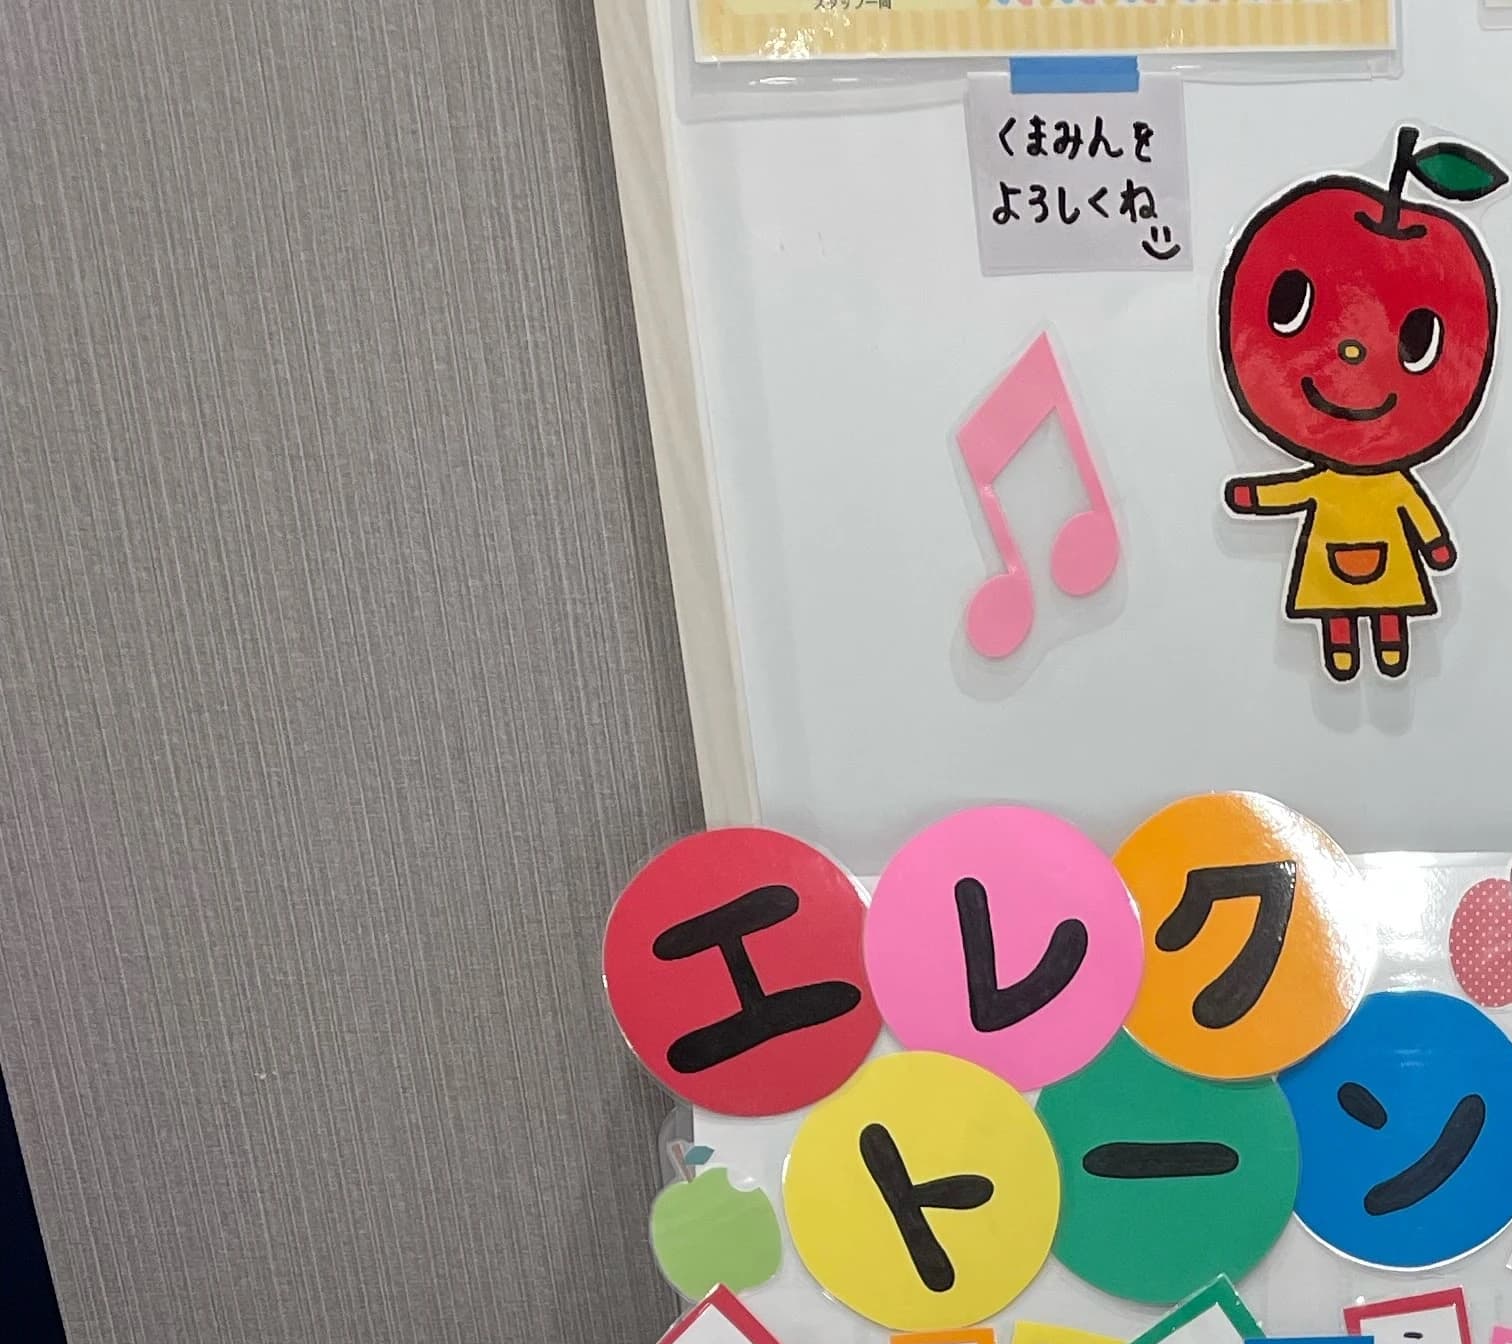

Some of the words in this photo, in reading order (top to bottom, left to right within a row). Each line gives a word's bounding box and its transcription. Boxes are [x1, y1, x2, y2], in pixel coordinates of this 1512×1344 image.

[998, 115, 1154, 162] くまみんを
[992, 178, 1158, 225] よろしくね
